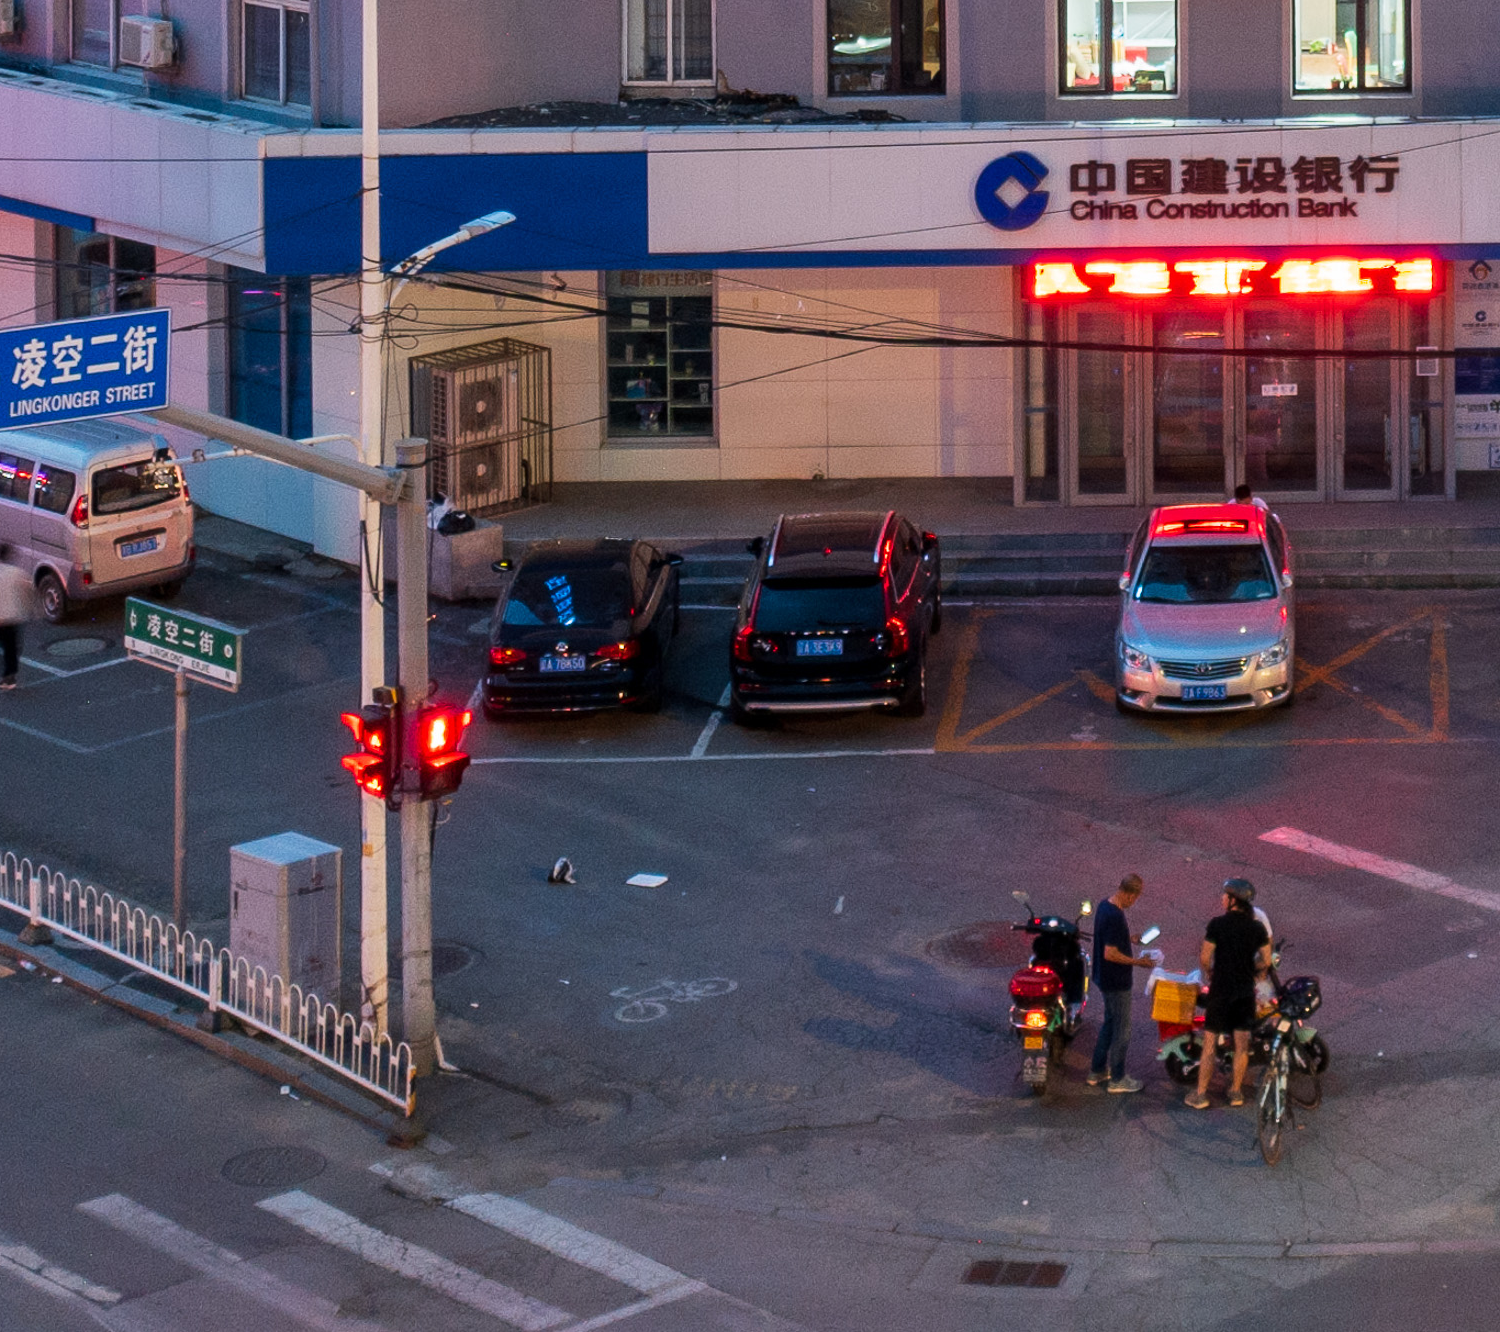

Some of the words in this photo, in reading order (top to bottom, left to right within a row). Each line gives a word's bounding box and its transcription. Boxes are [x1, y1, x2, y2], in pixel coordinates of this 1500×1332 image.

[1069, 155, 1400, 195] 中国建设银行
[1069, 198, 1137, 221] China
[1146, 198, 1290, 220] Construction
[1298, 197, 1358, 218] Bank
[12, 325, 158, 391] 凌空二街
[9, 390, 100, 418] LINGKONGER
[105, 382, 156, 405] STREET
[147, 614, 214, 656] 凌空二街
